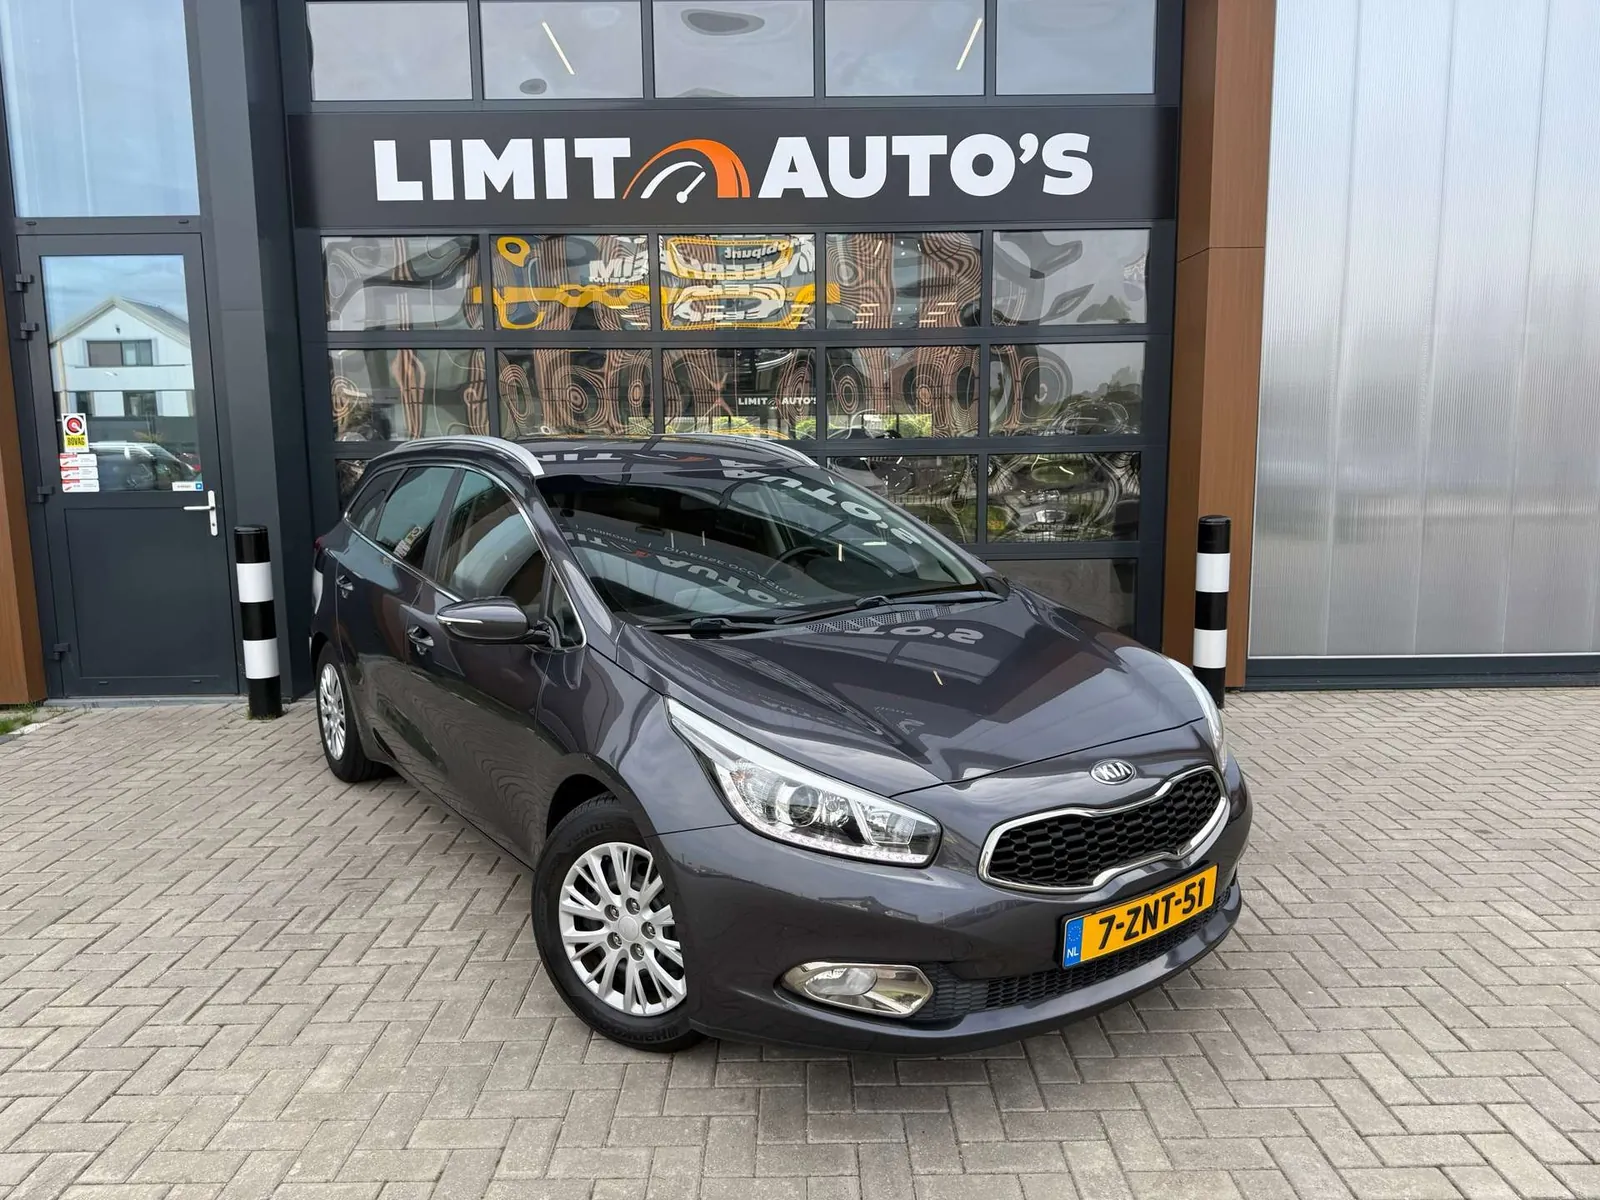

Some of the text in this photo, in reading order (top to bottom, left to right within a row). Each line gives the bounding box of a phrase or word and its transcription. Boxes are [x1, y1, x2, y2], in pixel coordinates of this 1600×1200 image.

[373, 132, 1093, 201] LIMIT AUTO'S
[738, 397, 768, 405] LIMIT
[67, 436, 86, 447] BOVAG
[1094, 762, 1131, 780] KIA
[1099, 877, 1206, 950] 7-ZNT-51
[1066, 948, 1079, 958] NL
